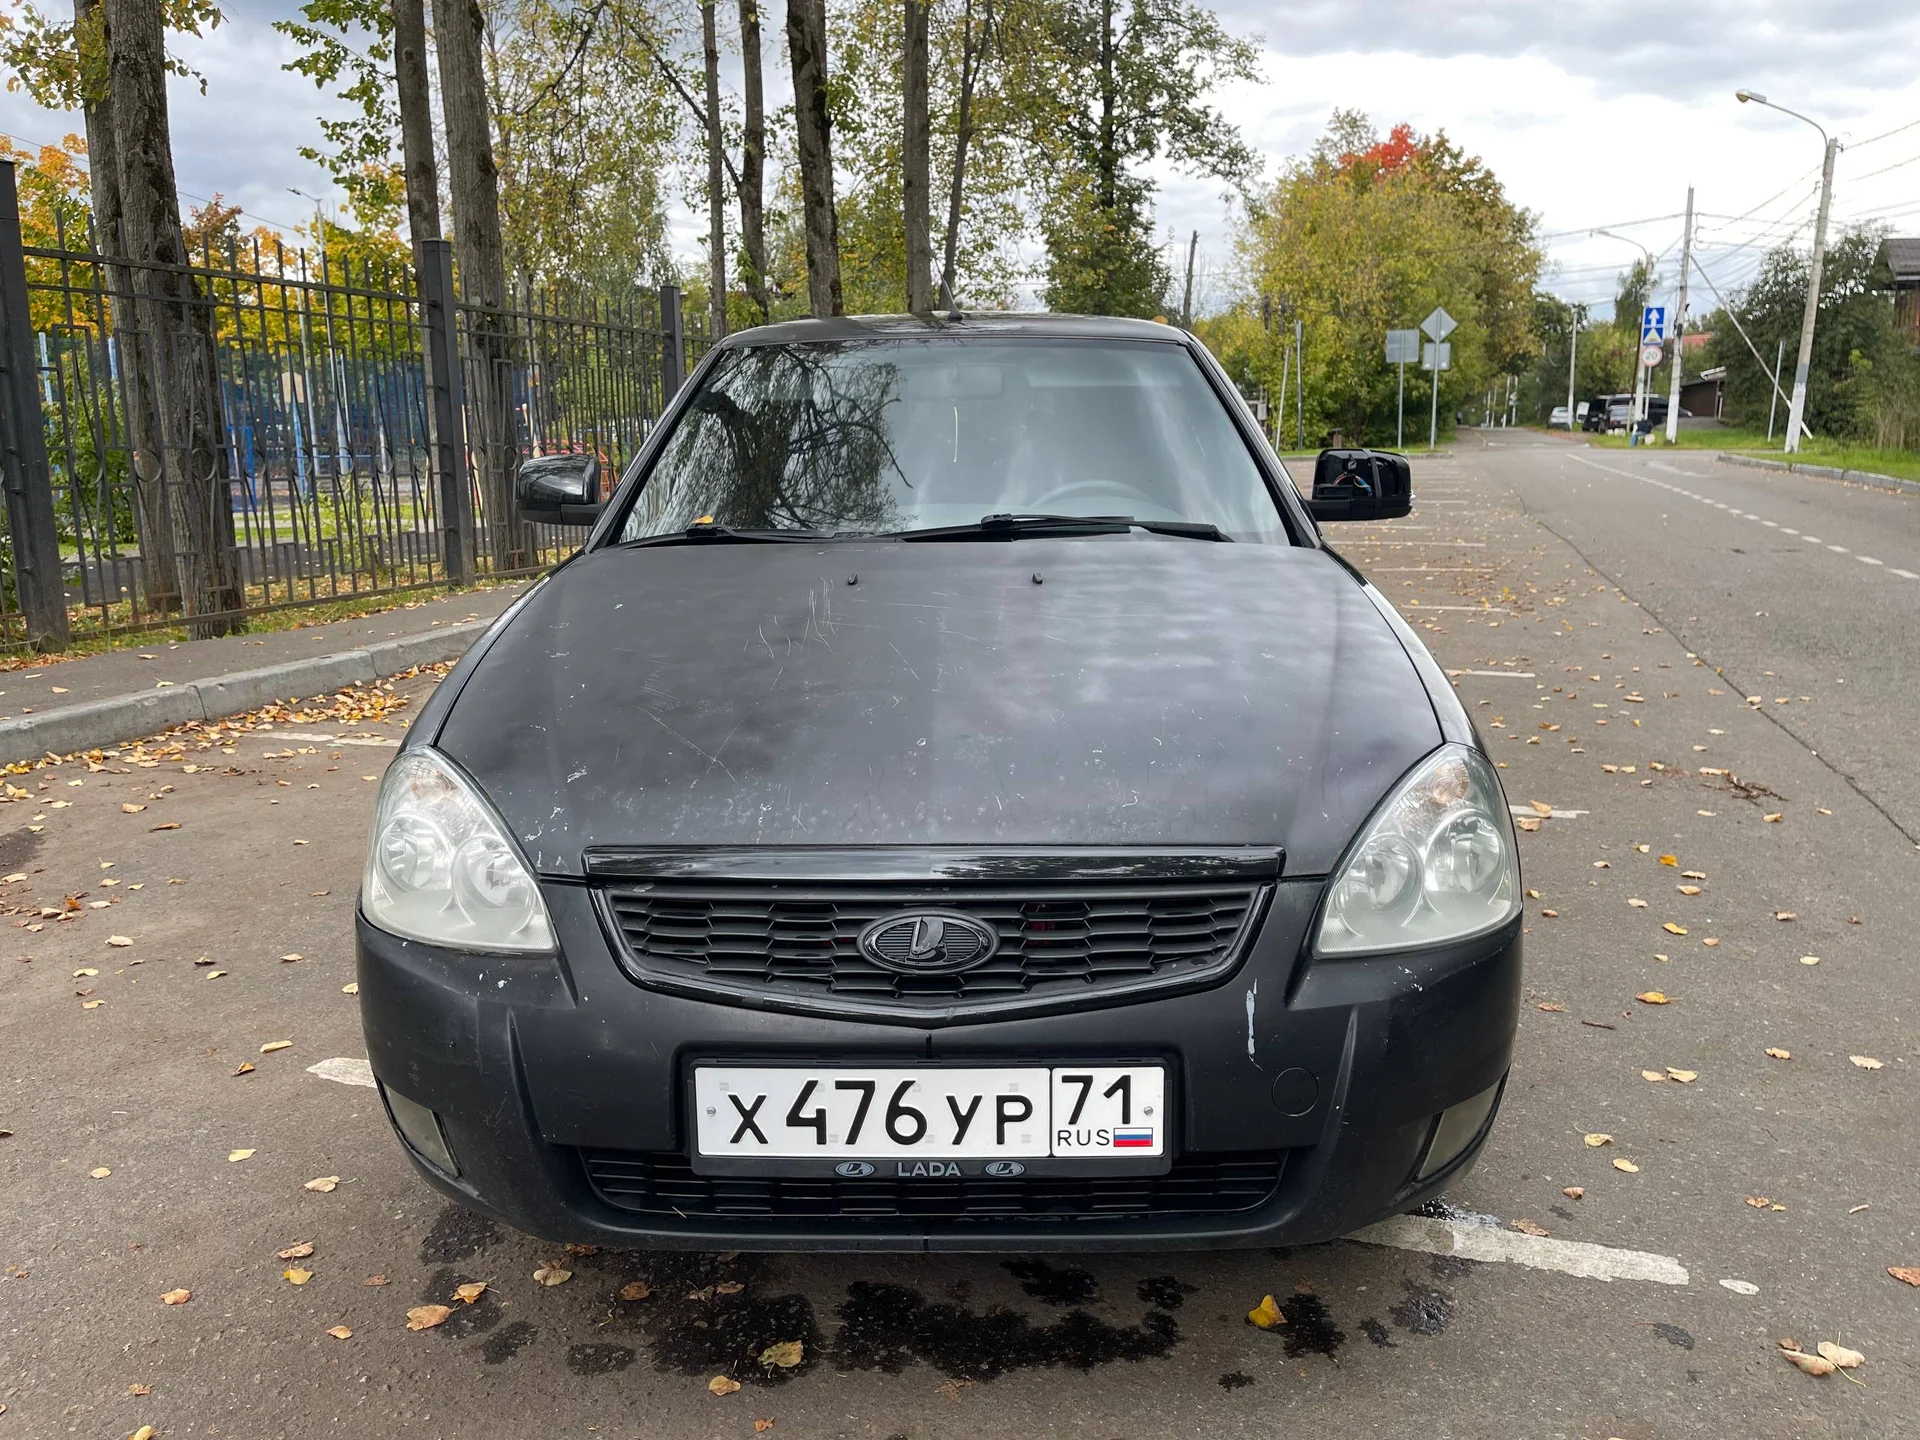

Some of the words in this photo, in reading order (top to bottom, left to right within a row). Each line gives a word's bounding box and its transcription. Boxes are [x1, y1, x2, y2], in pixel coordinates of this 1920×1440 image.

[1645, 351, 1658, 361] 20
[1061, 1074, 1131, 1126] 71
[1057, 1129, 1111, 1147] RUS
[897, 1161, 962, 1177] LADA
